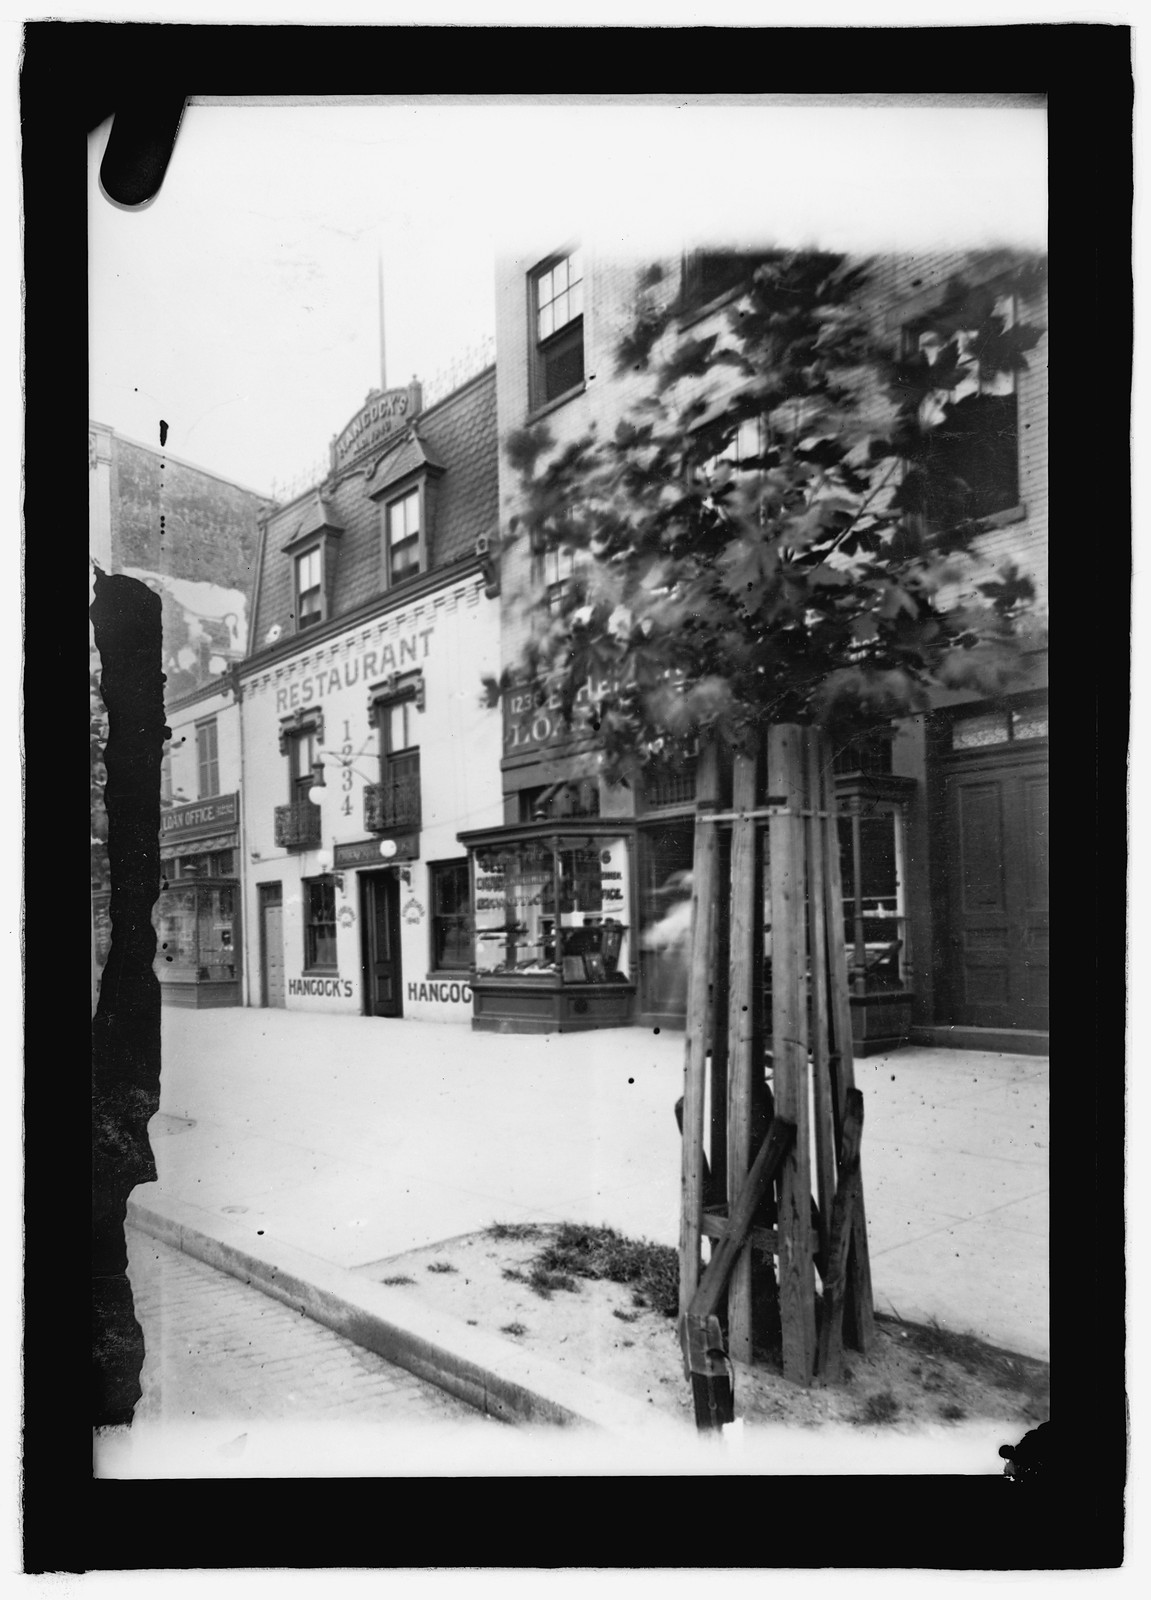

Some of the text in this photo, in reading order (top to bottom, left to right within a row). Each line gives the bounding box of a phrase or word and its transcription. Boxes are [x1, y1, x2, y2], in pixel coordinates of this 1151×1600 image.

[336, 396, 408, 459] HANCOCK'S
[276, 627, 434, 713] RESTAURANT
[341, 720, 354, 816] 1234
[162, 812, 184, 831] LOAN
[185, 806, 216, 825] OFFICE
[288, 979, 354, 998] HANCOCK'S
